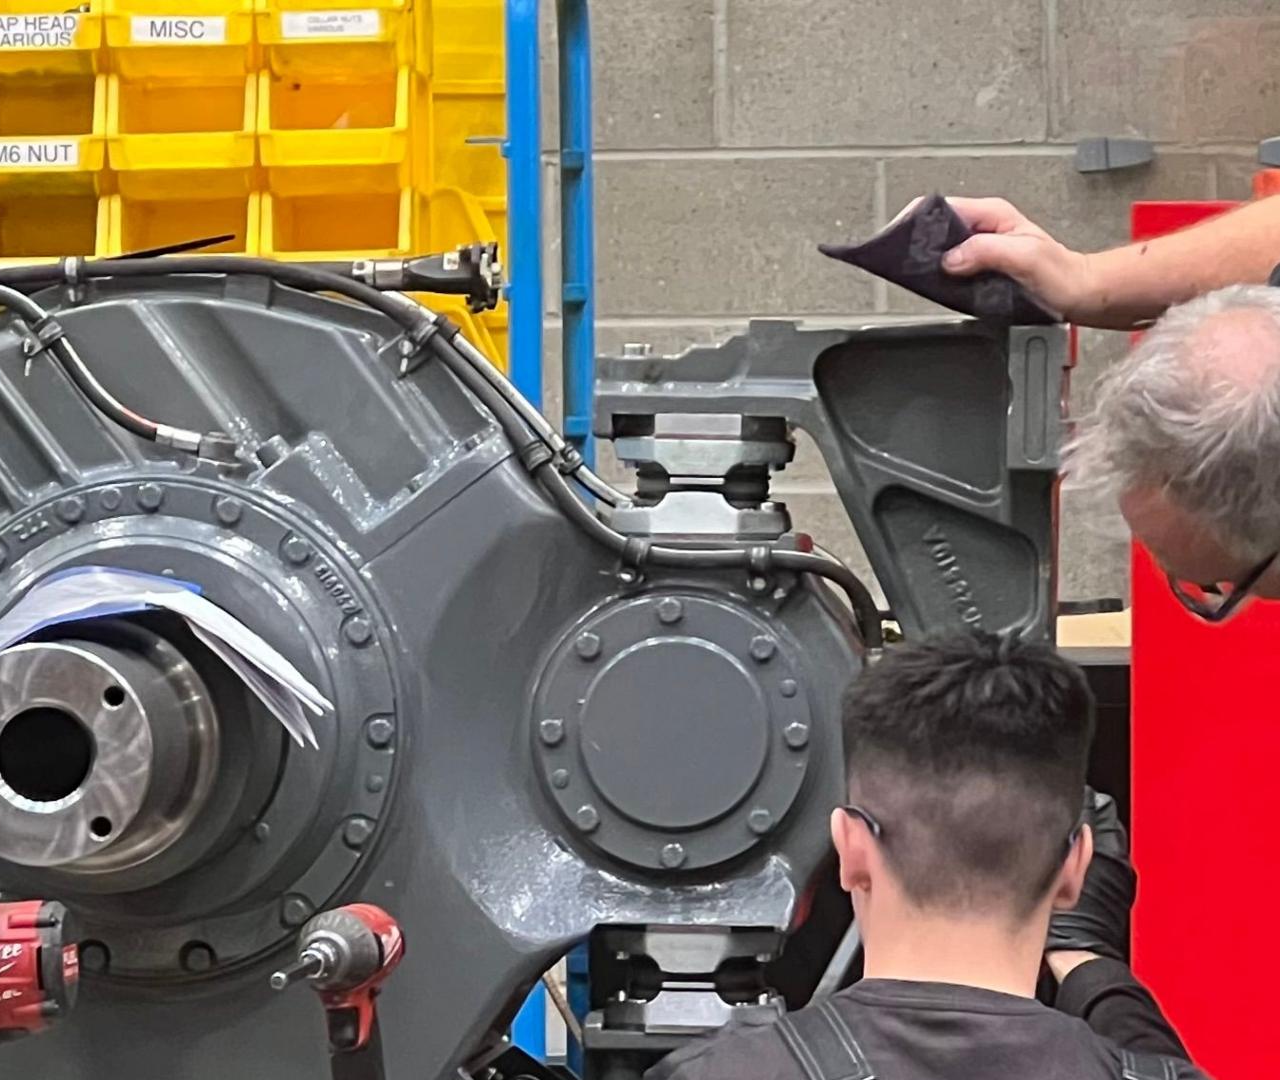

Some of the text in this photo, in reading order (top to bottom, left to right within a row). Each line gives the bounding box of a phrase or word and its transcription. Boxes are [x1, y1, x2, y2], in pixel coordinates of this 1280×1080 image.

[24, 15, 76, 33] HEAD
[149, 20, 206, 39] MISC
[27, 144, 73, 163] NUT
